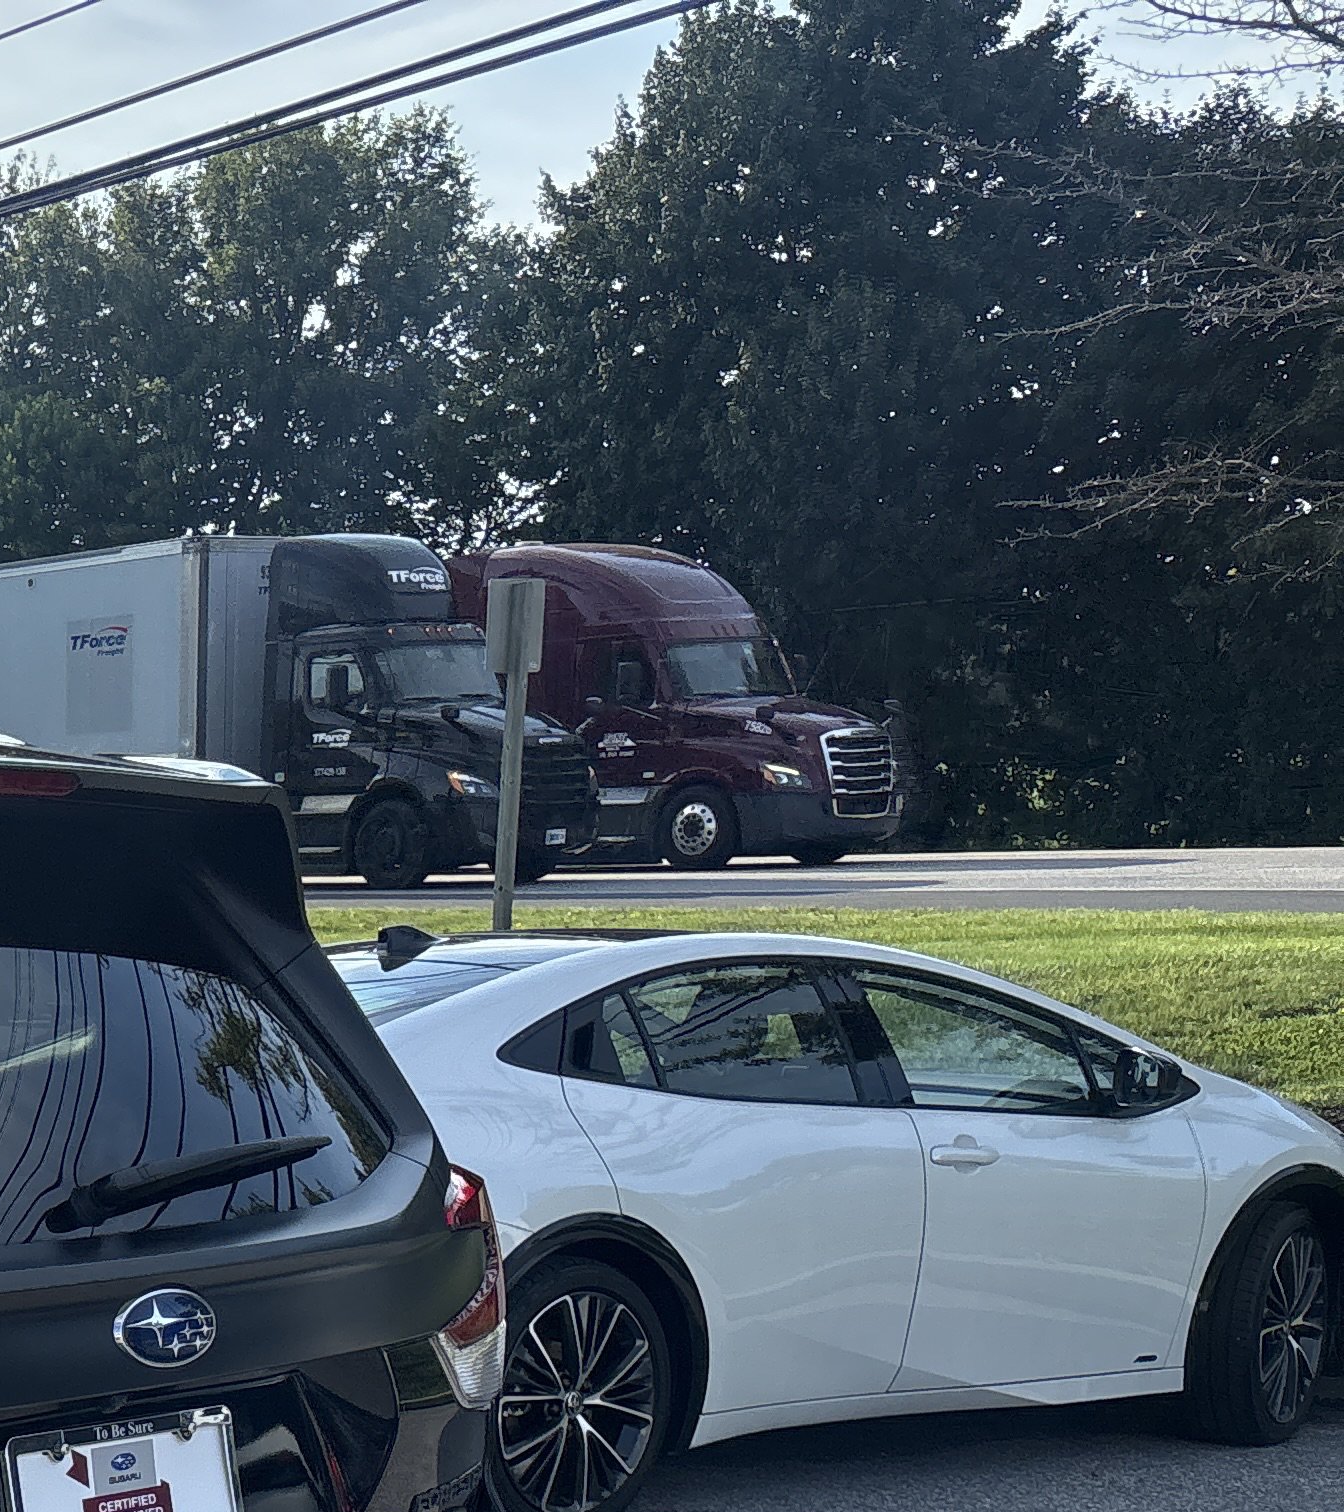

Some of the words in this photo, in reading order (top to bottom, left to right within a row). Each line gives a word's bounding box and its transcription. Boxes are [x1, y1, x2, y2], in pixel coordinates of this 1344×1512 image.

[387, 570, 445, 584] TForce
[70, 633, 127, 651] TForce
[93, 1426, 108, 1440] To
[111, 1424, 126, 1439] Be
[128, 1420, 155, 1437] Sure
[109, 1472, 142, 1485] SUBARU
